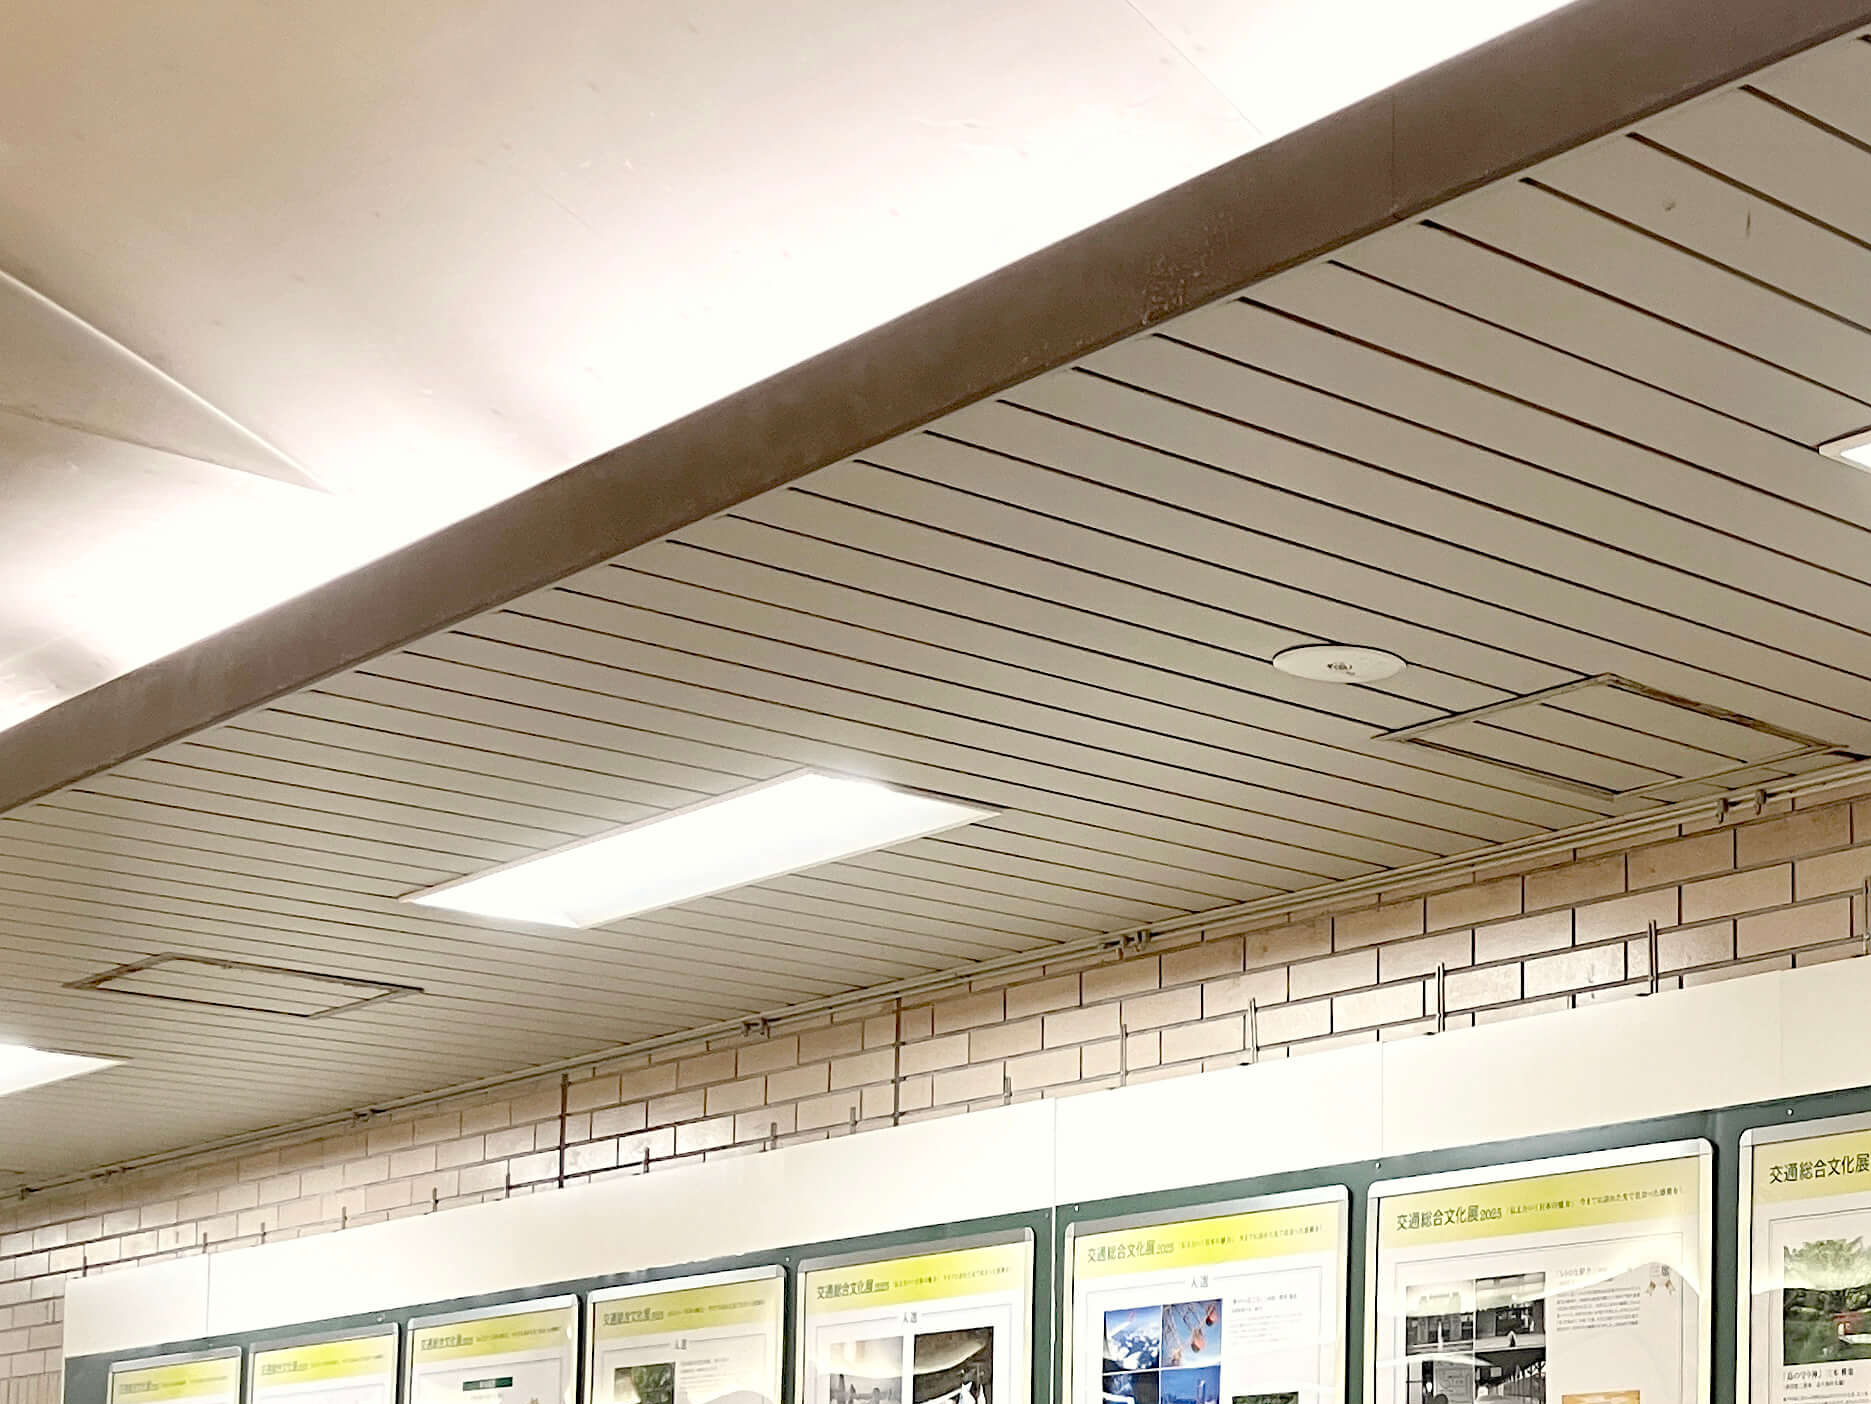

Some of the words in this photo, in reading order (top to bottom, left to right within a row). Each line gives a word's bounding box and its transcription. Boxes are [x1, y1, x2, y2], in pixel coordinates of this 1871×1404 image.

[1396, 1204, 1502, 1231] 交通総合文化展2025
